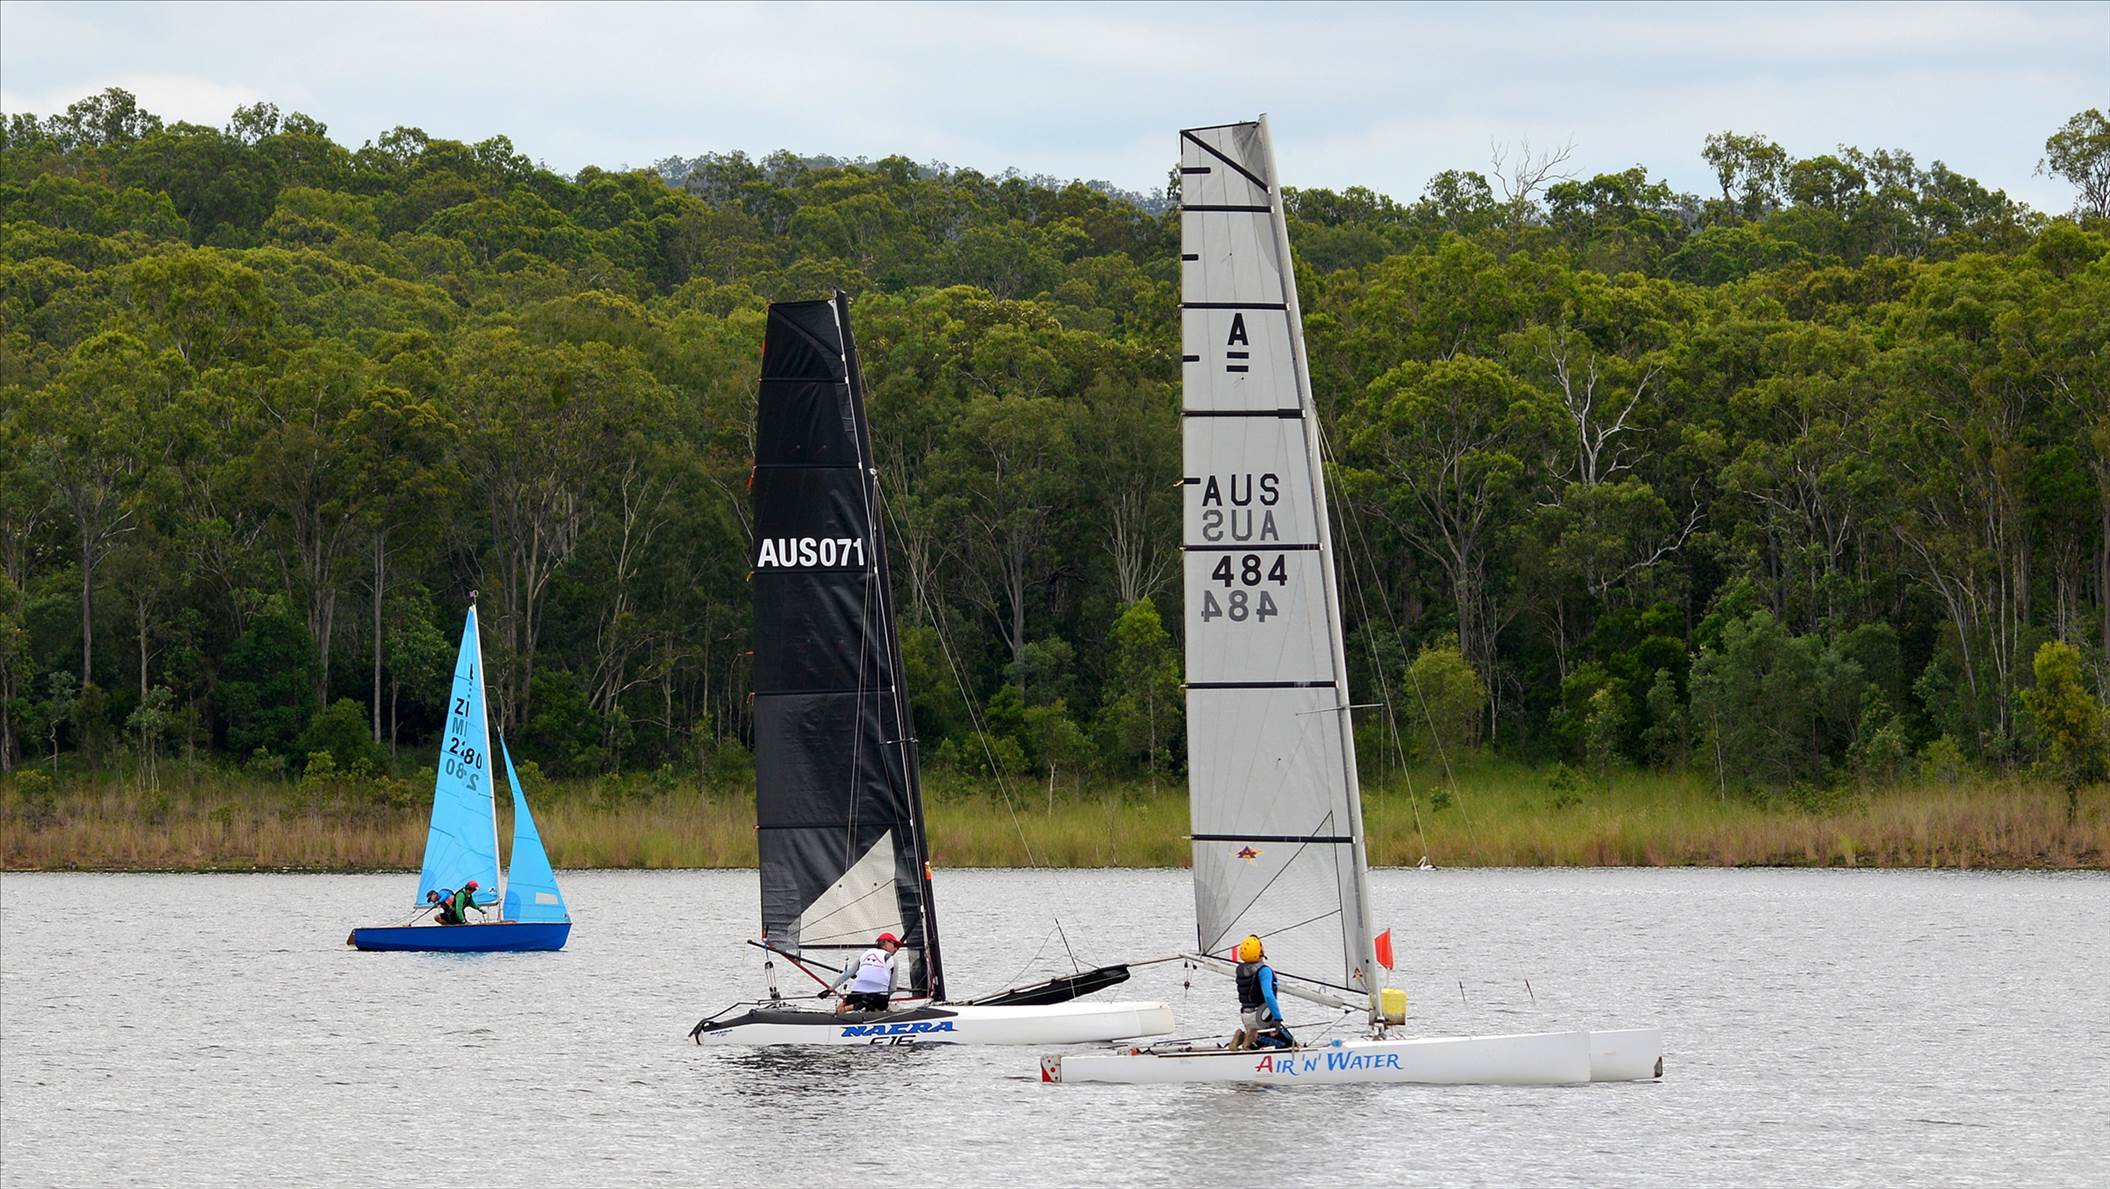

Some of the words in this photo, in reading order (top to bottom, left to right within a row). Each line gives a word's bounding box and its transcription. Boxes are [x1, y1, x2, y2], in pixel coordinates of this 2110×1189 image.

[1202, 473, 1280, 507] AUS
[757, 537, 865, 567] AUS071
[1211, 554, 1288, 588] 484
